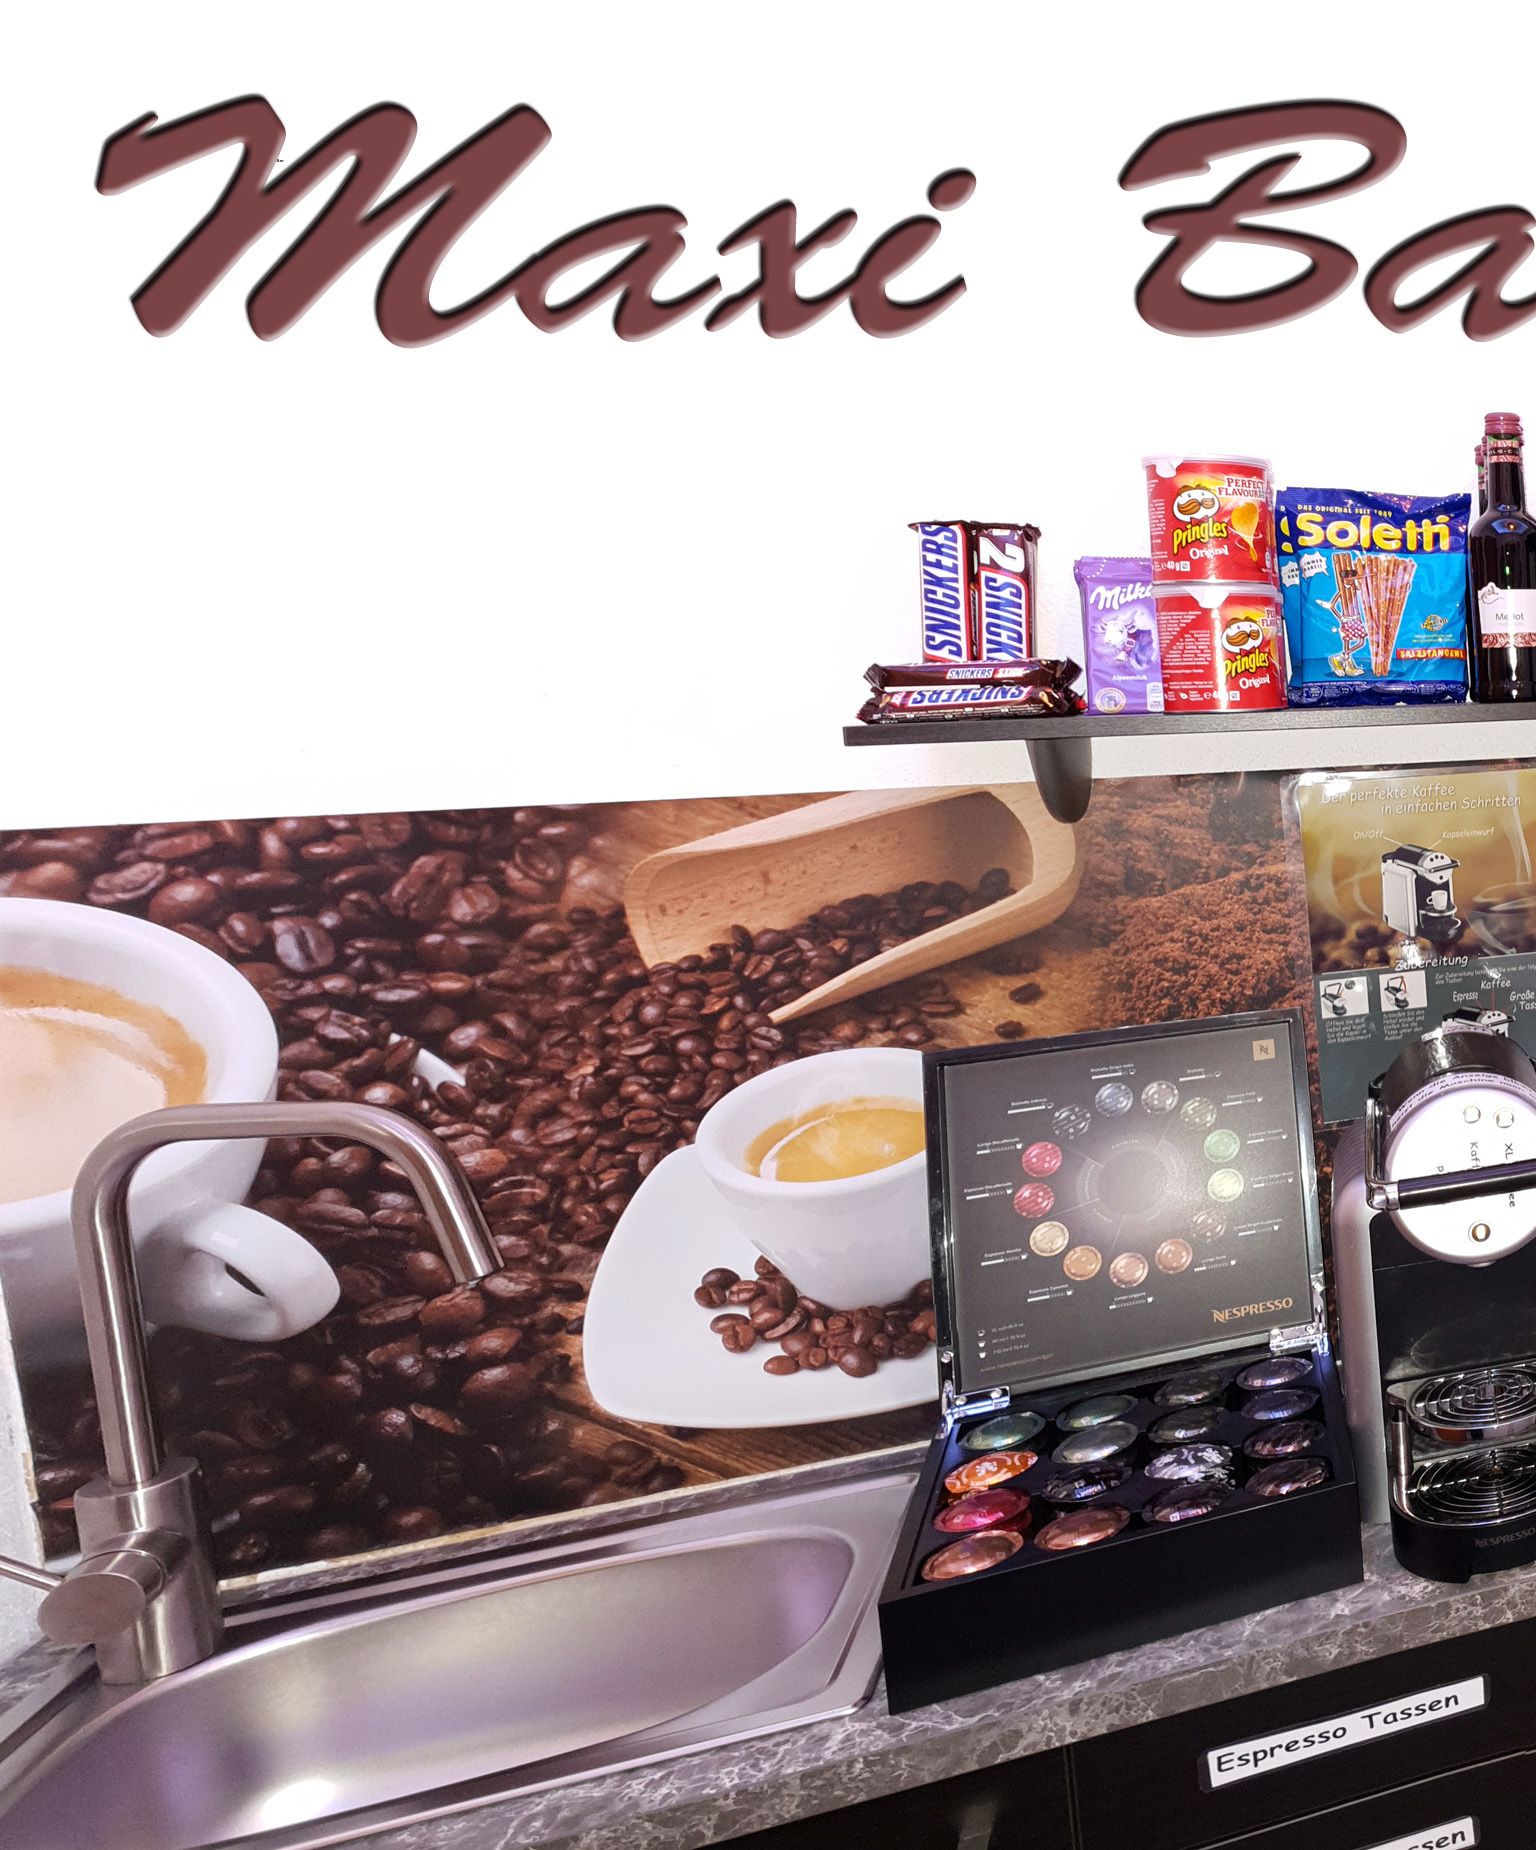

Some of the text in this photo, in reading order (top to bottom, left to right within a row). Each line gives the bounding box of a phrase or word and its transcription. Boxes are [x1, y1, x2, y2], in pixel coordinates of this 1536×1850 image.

[1227, 478, 1264, 490] PERFECT
[1320, 505, 1352, 514] ORIGINAL
[1173, 518, 1229, 556] Pringles
[1296, 511, 1451, 551] Soletti
[1190, 545, 1229, 560] Original
[920, 524, 964, 659] SNICKERS
[1495, 612, 1525, 622] Melot
[1224, 648, 1270, 678] Pringles
[1400, 650, 1465, 660] SALZSTANGERL
[948, 668, 994, 680] SNICKERS
[1112, 674, 1149, 682] Alpenmilch
[1239, 675, 1271, 689] Original
[911, 685, 1025, 706] SNICKERS
[1351, 785, 1408, 805] perfekte
[1412, 782, 1456, 799] Kaffee
[1381, 794, 1522, 815] in einfachen Schritten
[1394, 954, 1469, 972] Zubereitung
[1480, 977, 1511, 990] Kaffee
[1453, 990, 1535, 1003] Espresso Große
[1212, 1297, 1294, 1323] NESPRESSO
[1473, 1526, 1536, 1549] NESPRESSO
[1216, 1693, 1460, 1773] Espresso Tassen
